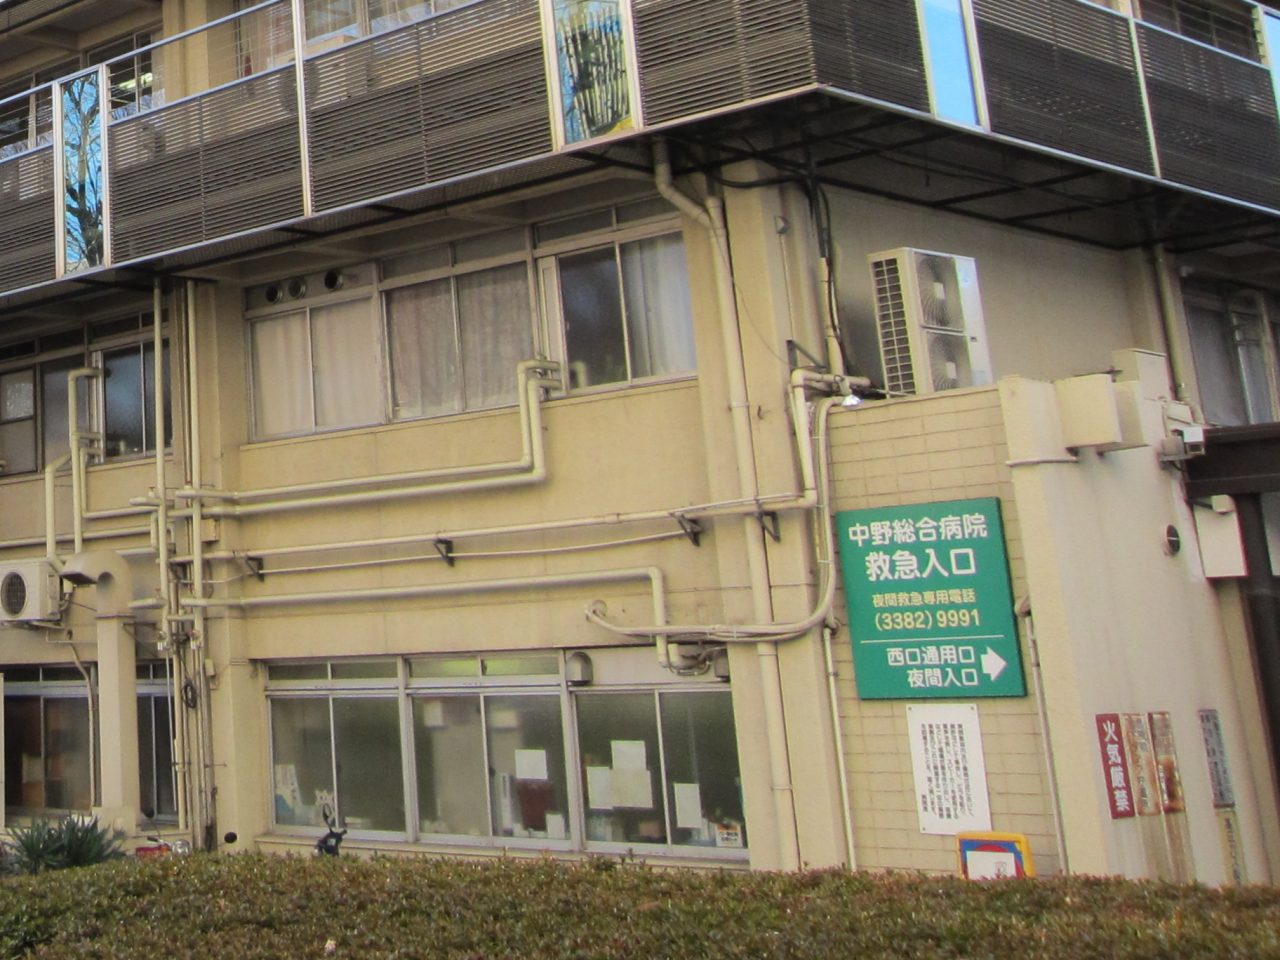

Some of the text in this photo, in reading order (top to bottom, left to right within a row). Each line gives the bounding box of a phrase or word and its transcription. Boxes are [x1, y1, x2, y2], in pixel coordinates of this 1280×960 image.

[848, 513, 988, 547] 中野総合病院
[865, 548, 977, 582] 救急入口
[872, 588, 977, 608] 夜間救急専用電話
[886, 645, 976, 666] 西口通用口
[907, 668, 979, 688] 夜間入口
[1103, 720, 1130, 812] 火気厳禁
